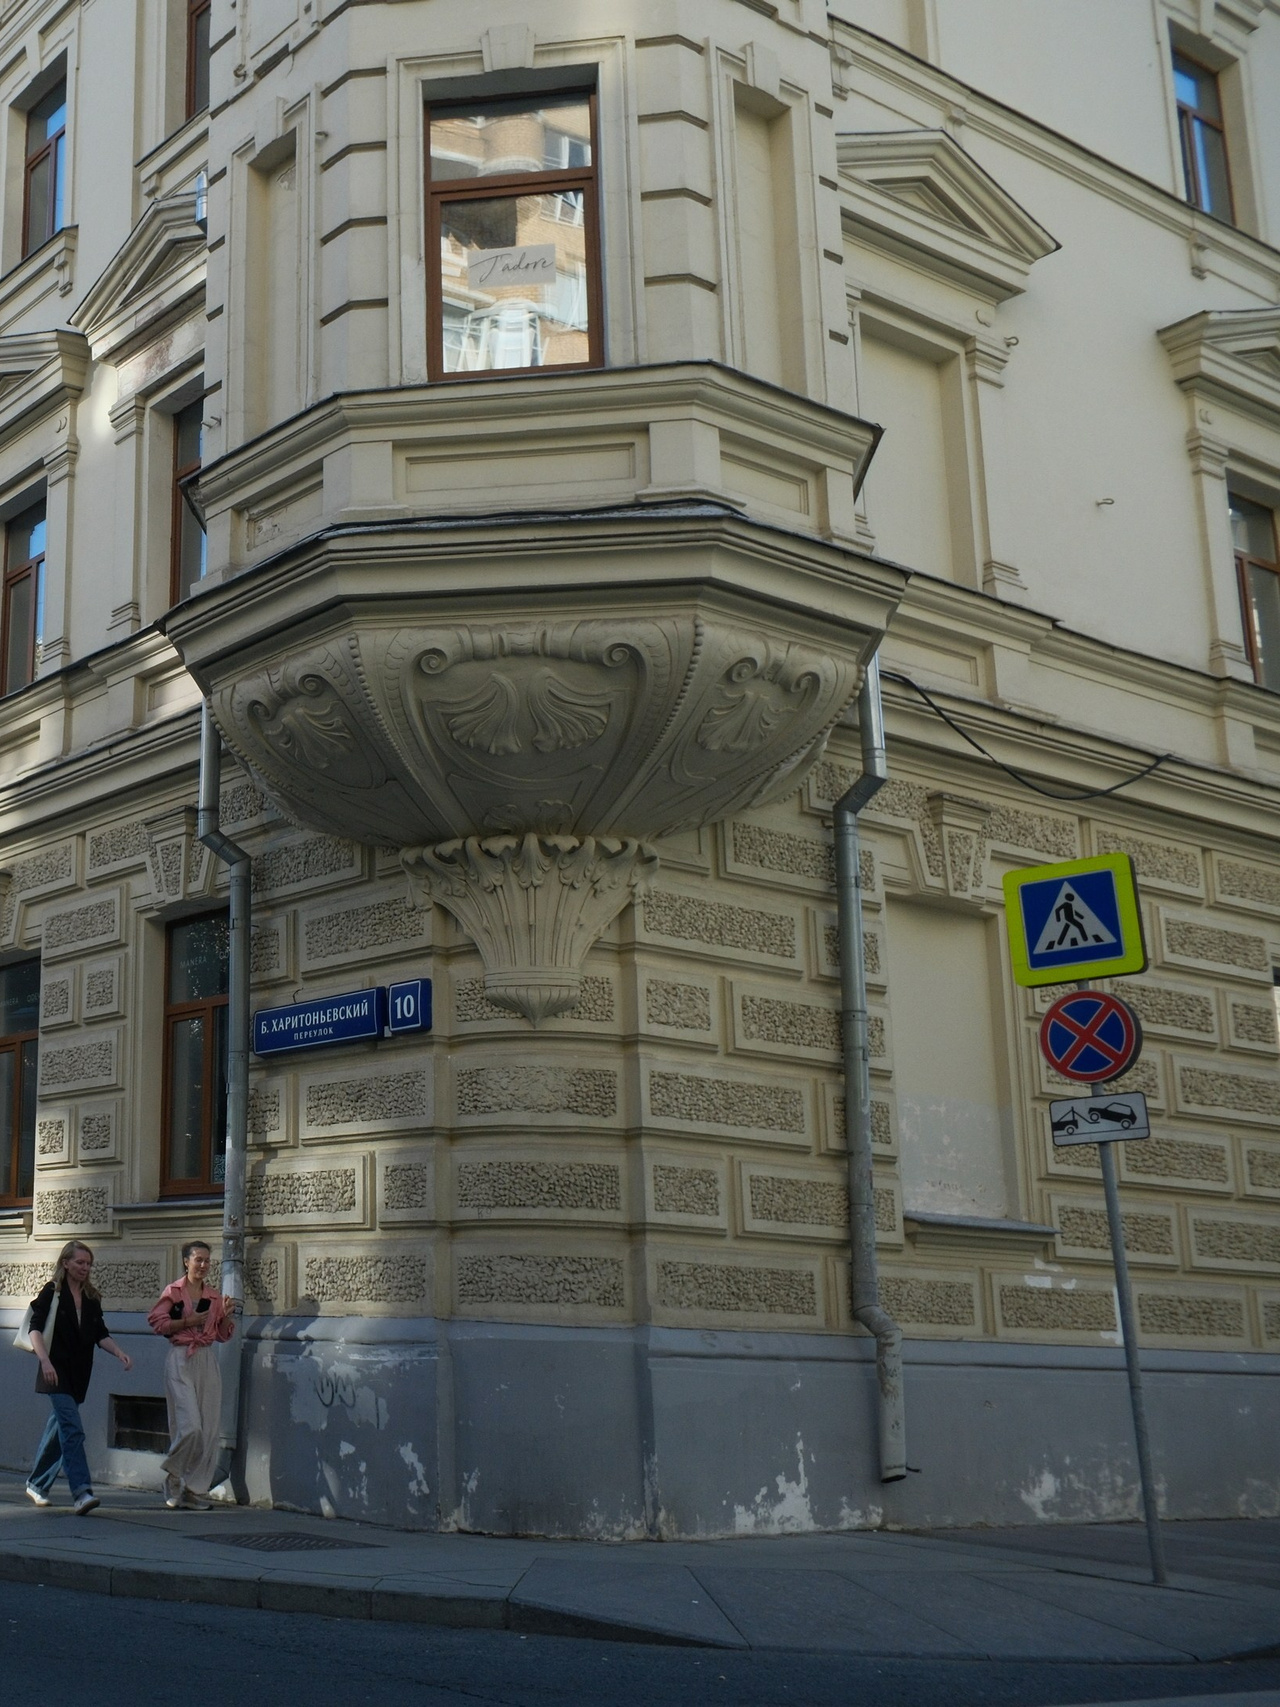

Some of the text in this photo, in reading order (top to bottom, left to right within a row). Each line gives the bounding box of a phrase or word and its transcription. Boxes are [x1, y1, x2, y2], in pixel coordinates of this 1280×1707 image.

[469, 252, 553, 283] J'adore
[180, 955, 207, 968] MANERA
[261, 998, 369, 1034] Б. ХАРИТОНЬЕВСКИЙ
[394, 994, 415, 1019] 10
[293, 1026, 334, 1041] ПЕРЕУЛОК
